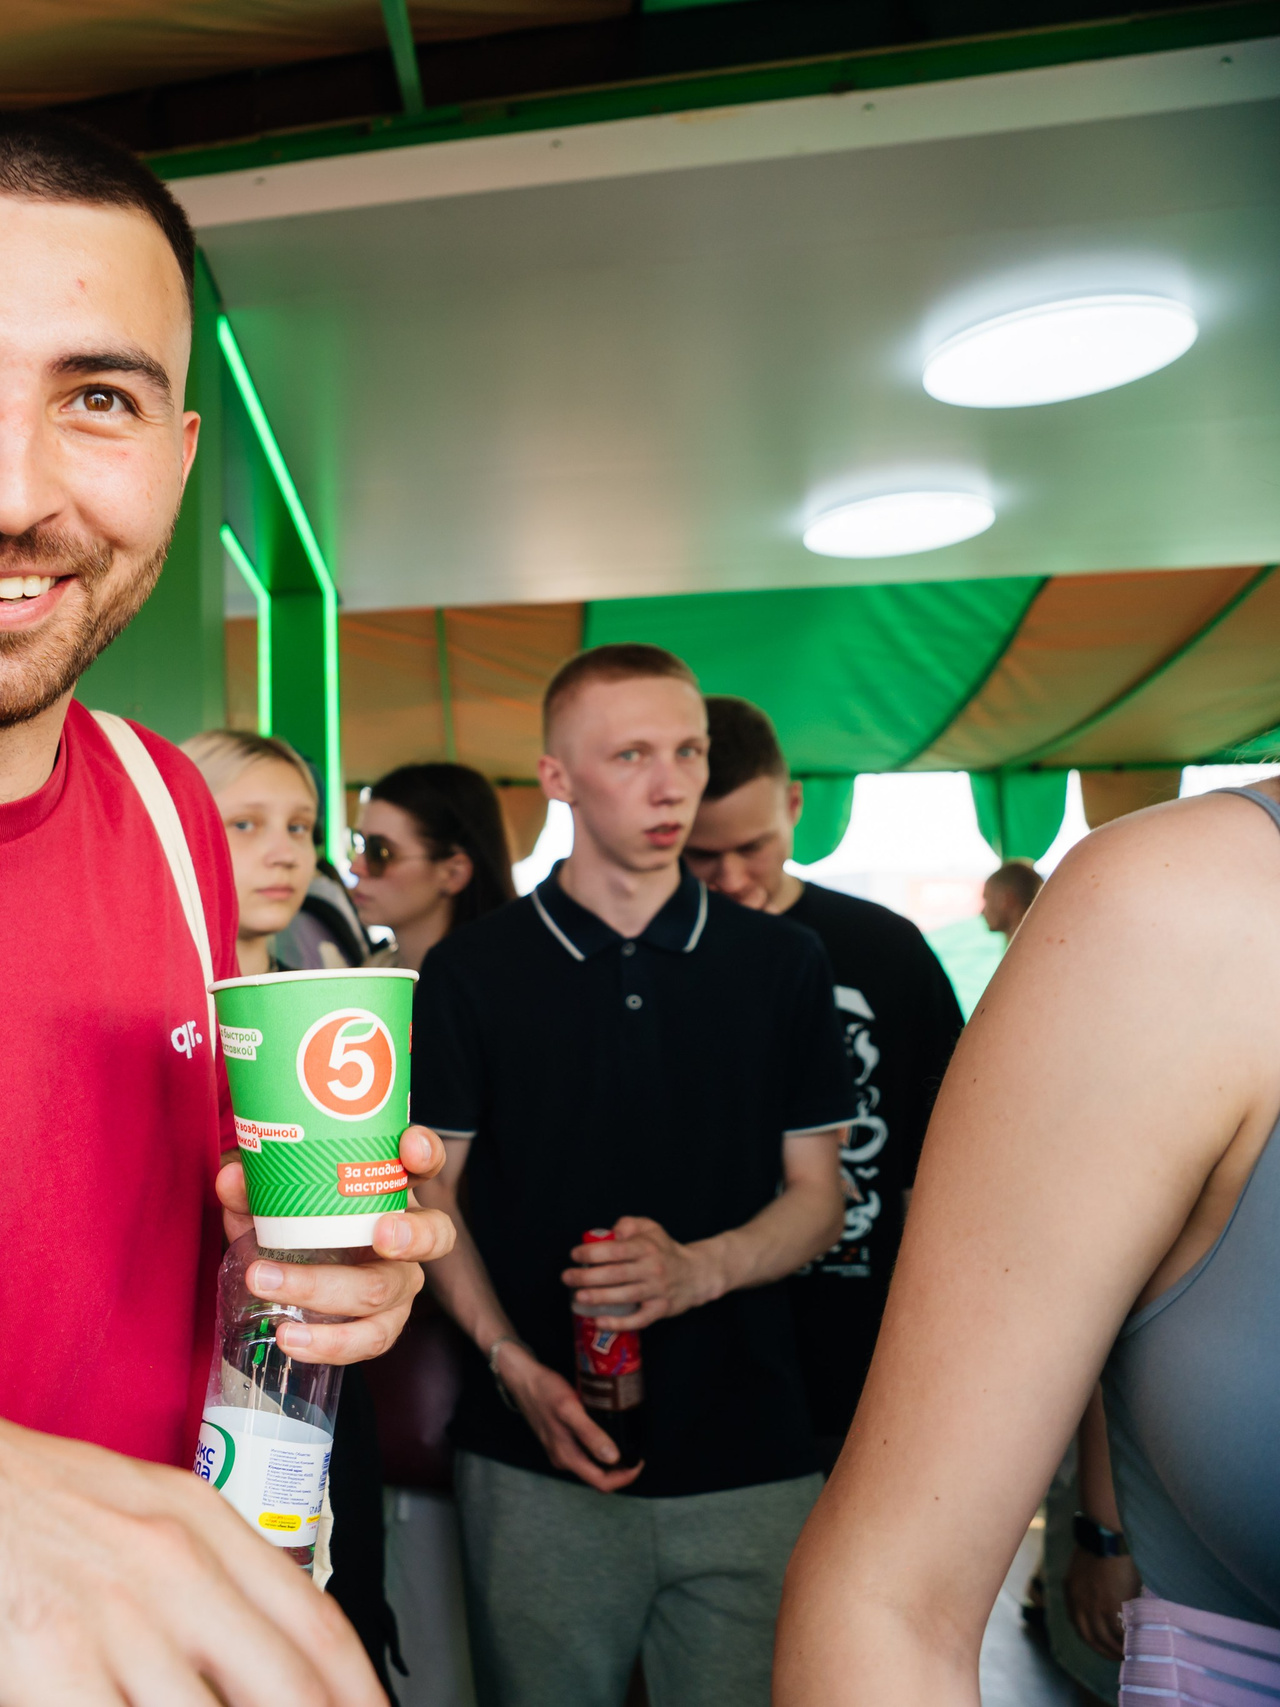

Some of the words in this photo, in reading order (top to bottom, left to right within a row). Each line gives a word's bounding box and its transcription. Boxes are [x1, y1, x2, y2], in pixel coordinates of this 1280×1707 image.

[224, 1028, 257, 1043] быстрой
[325, 1018, 379, 1101] 5
[240, 1122, 298, 1139] воздушной
[344, 1166, 361, 1178] За
